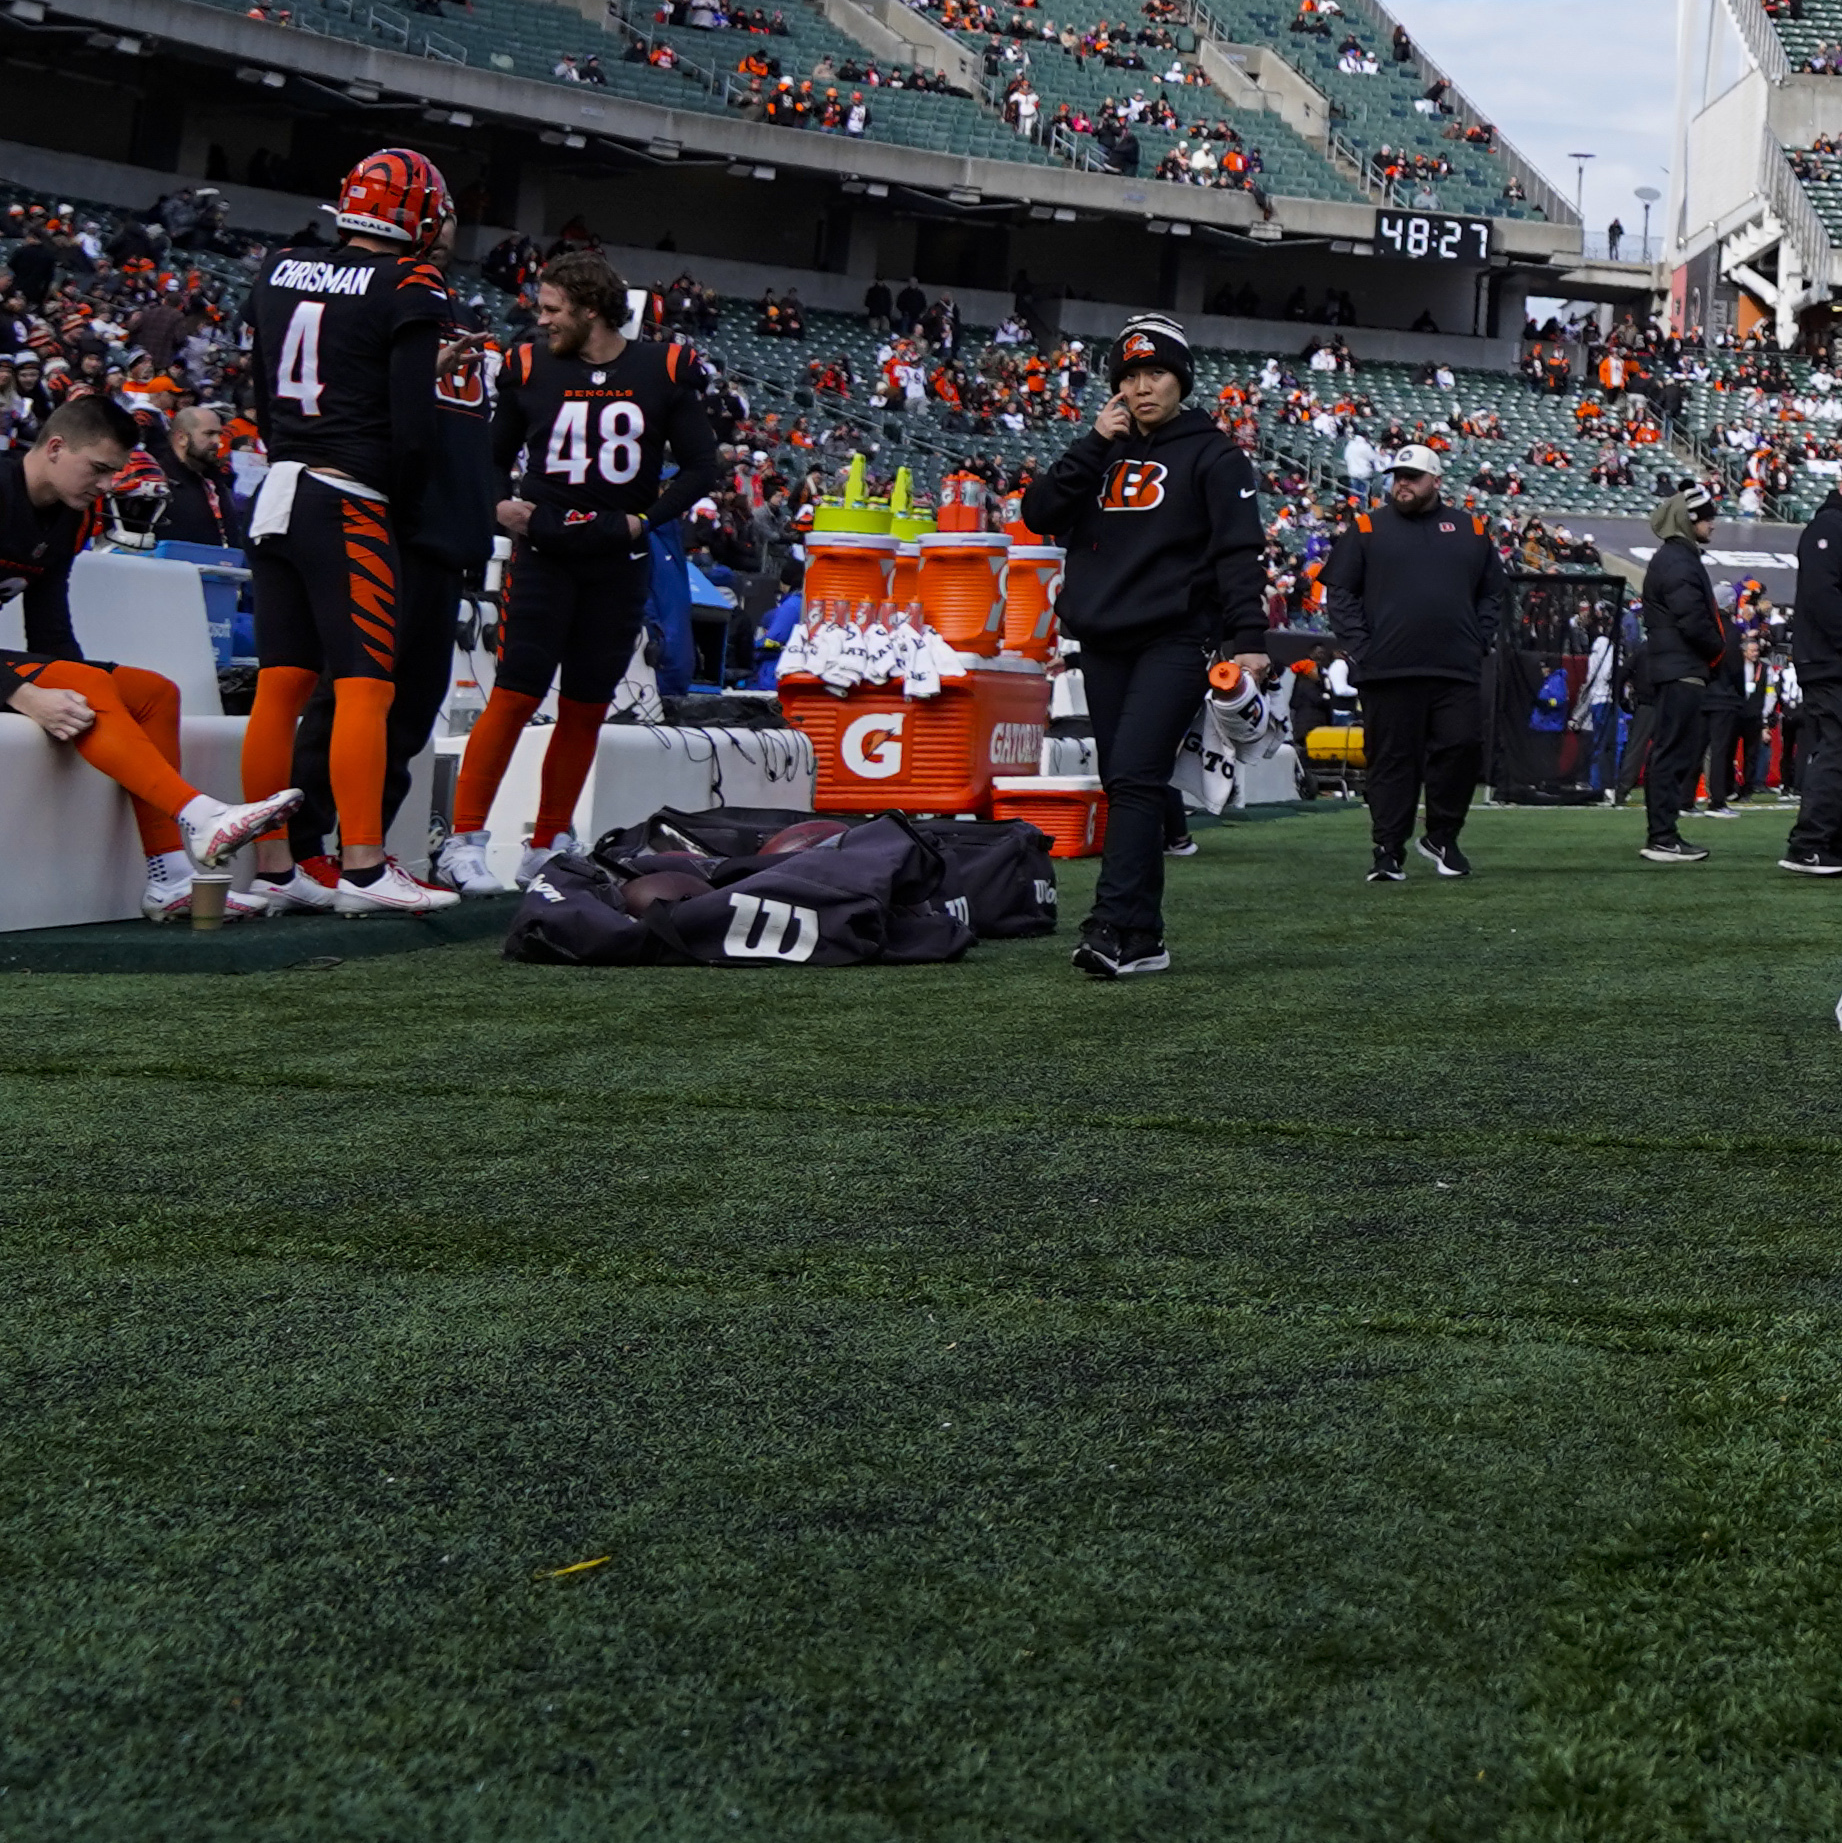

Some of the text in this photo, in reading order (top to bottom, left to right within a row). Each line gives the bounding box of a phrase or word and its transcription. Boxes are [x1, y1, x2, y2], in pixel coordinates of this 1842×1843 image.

[341, 216, 393, 234] BENGALS
[1381, 217, 1488, 259] 48:27
[270, 258, 376, 296] CHRISMAN
[277, 300, 327, 417] 4
[564, 389, 634, 398] BENGALS
[545, 400, 645, 485] 48
[841, 712, 906, 779] G
